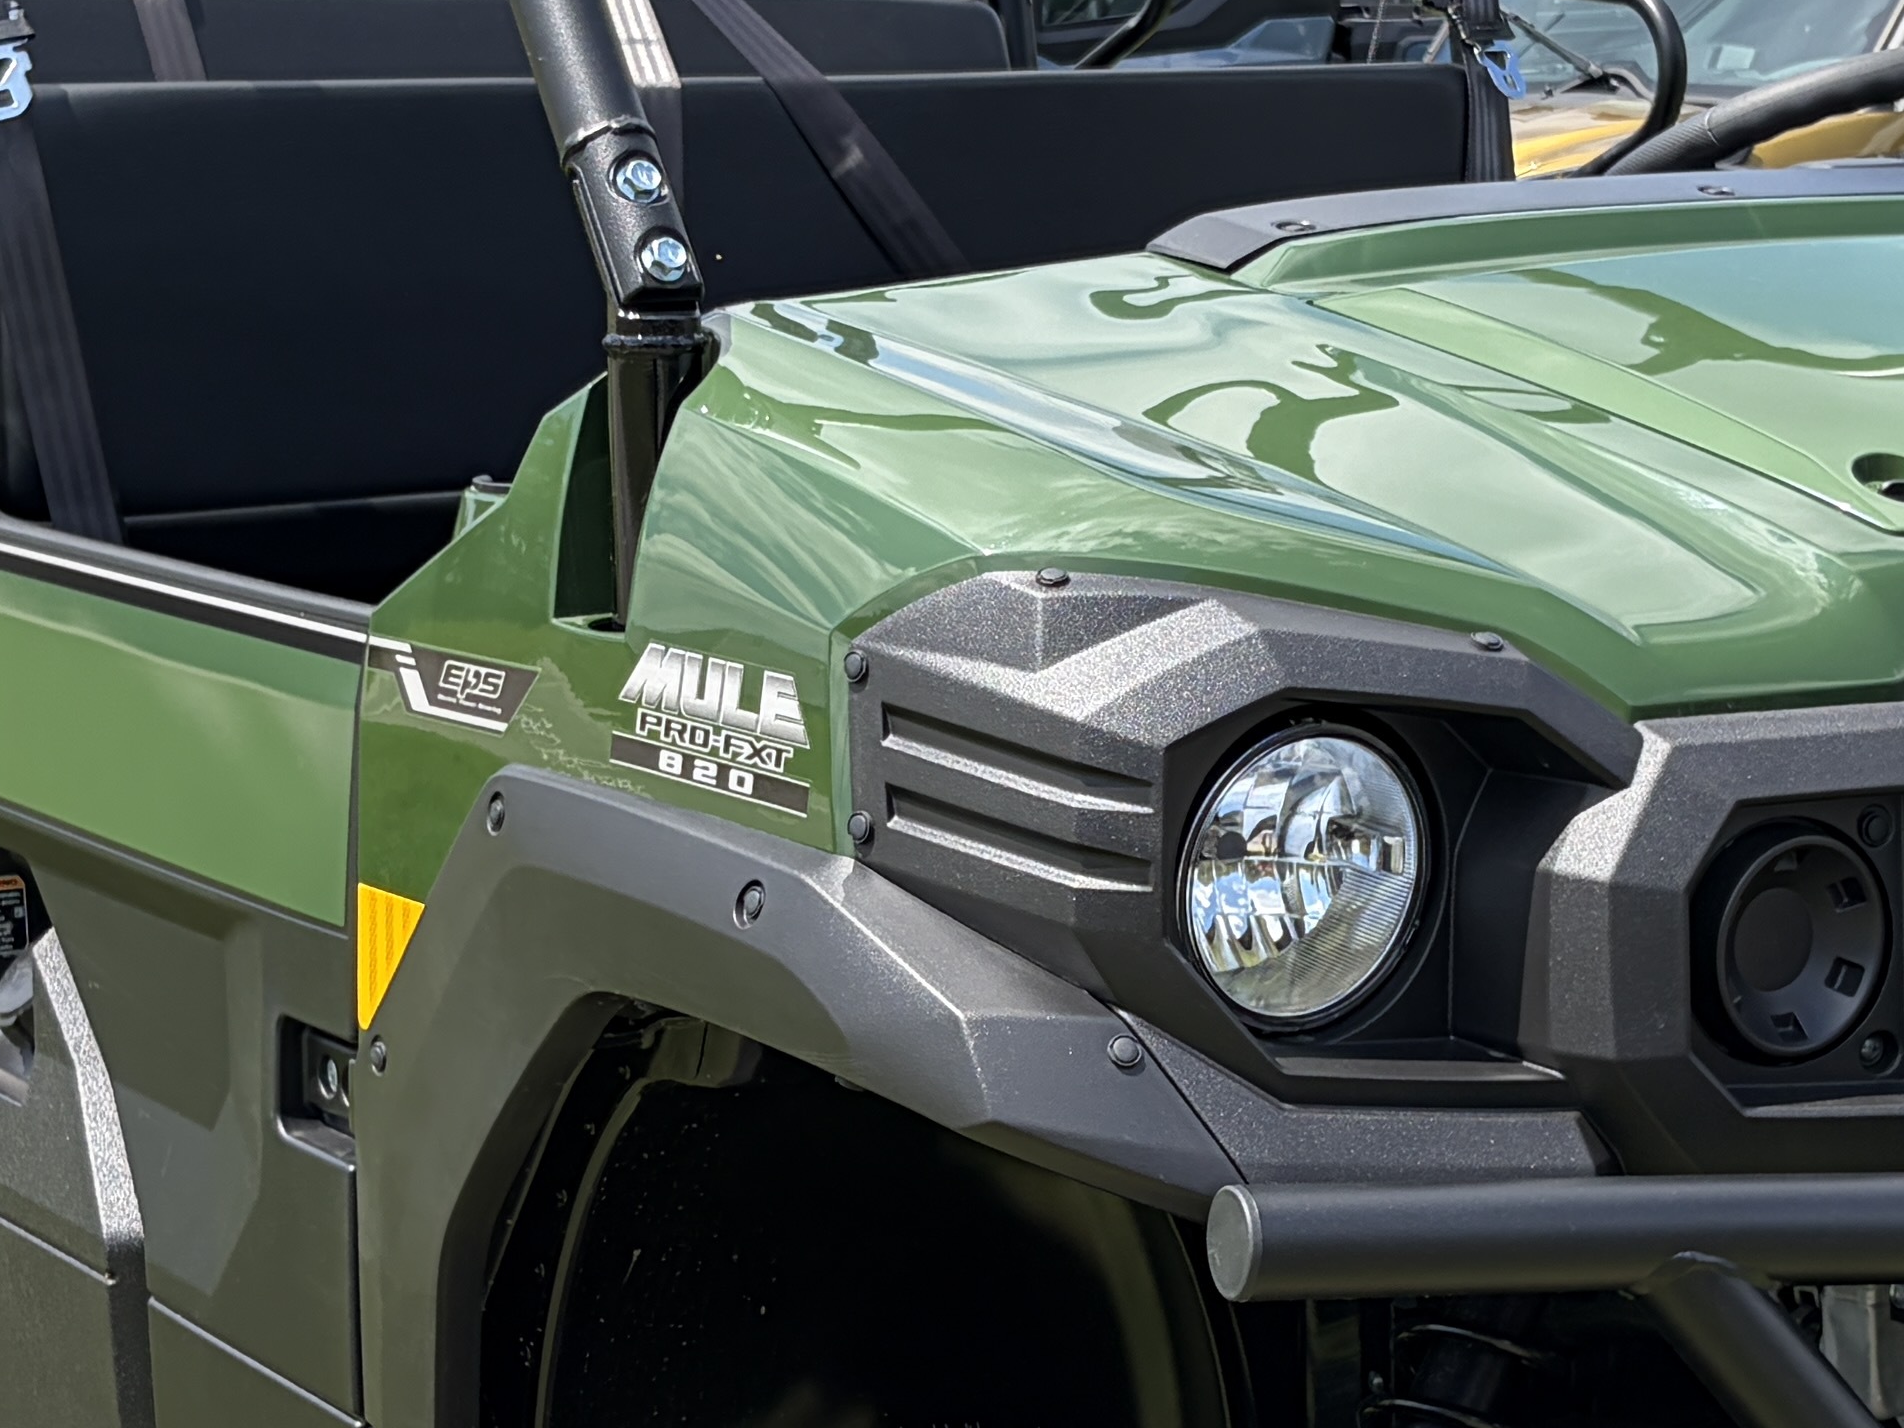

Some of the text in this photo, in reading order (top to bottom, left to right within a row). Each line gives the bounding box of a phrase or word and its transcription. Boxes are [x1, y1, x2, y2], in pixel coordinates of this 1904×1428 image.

[438, 659, 506, 699] EPS
[618, 642, 811, 750] MULE
[635, 707, 794, 773] PRO-FXT
[658, 748, 755, 796] 820
